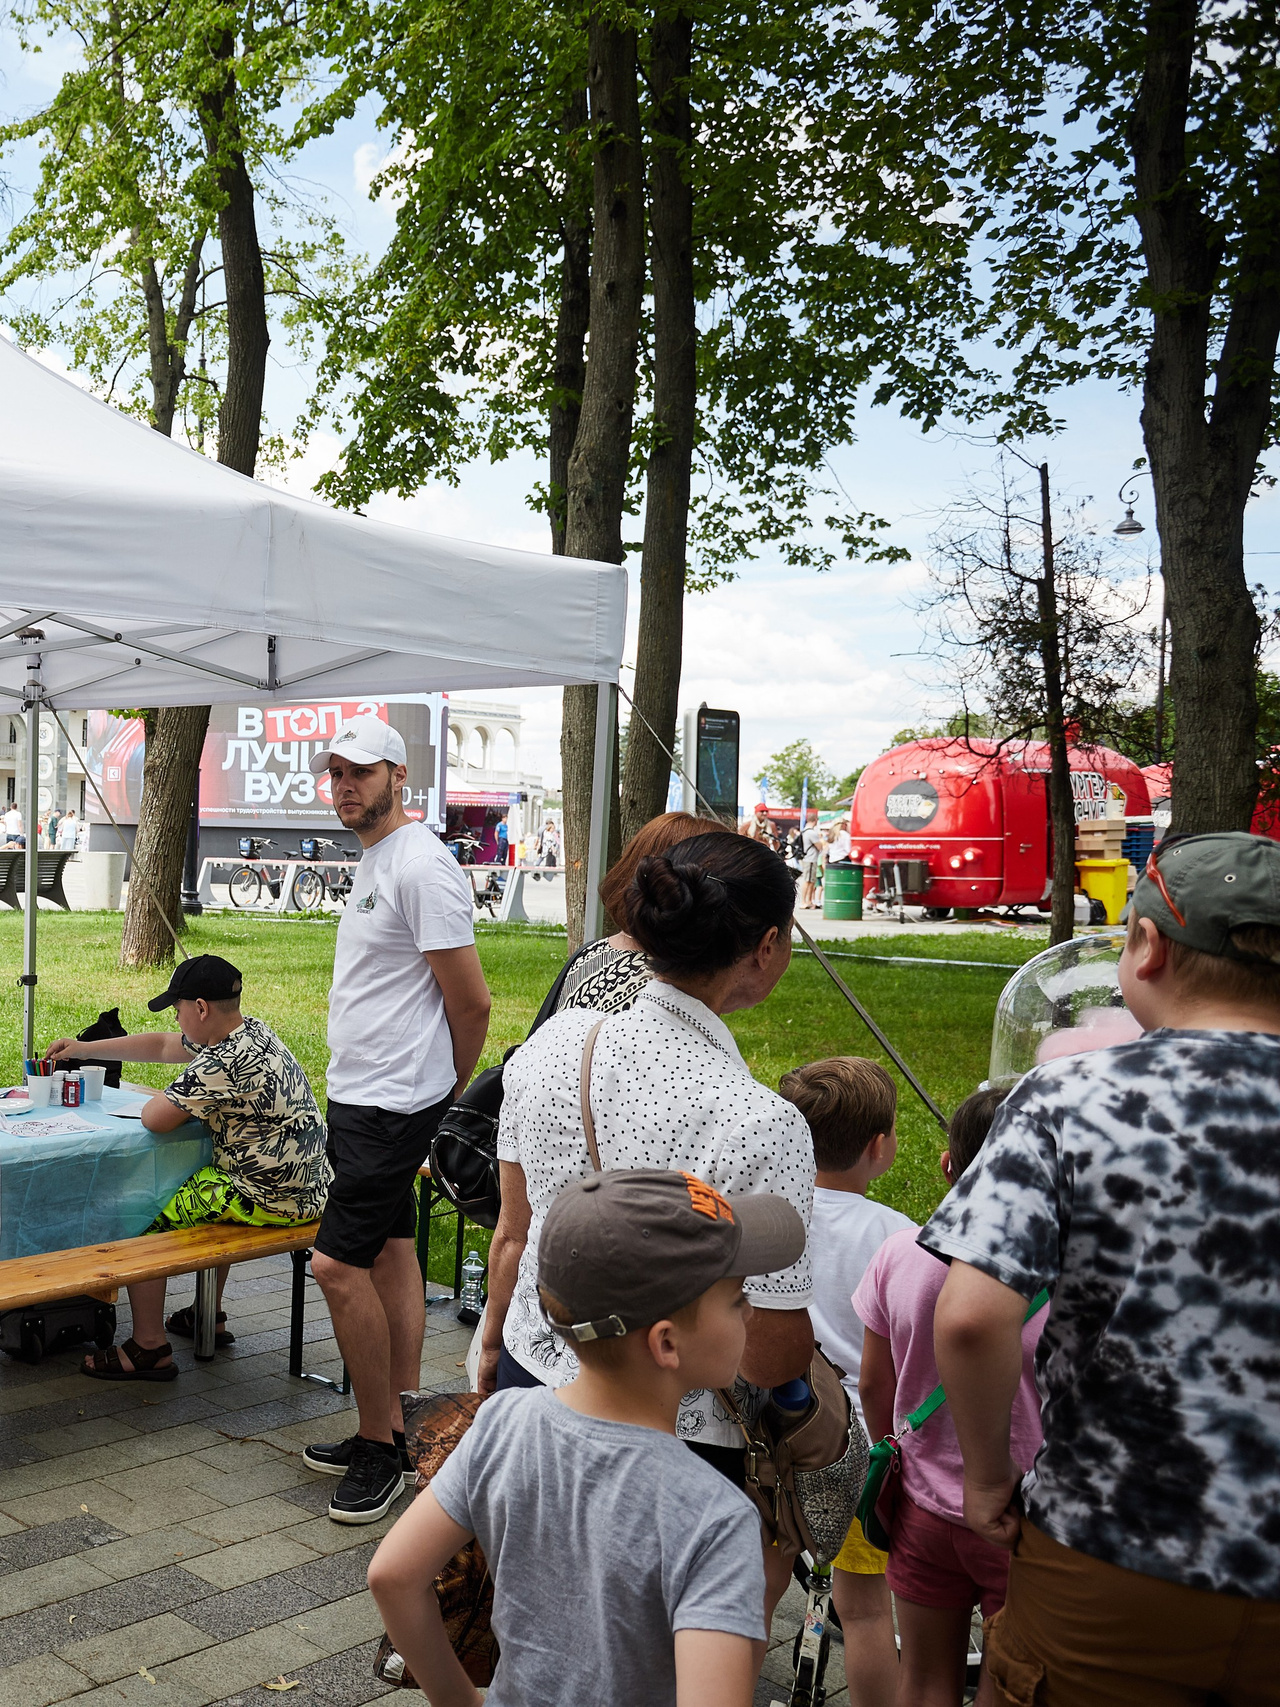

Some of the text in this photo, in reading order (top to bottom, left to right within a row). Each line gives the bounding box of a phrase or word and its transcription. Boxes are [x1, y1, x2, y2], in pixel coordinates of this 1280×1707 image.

[237, 707, 263, 738] В
[1069, 771, 1106, 799] УРГЕР
[236, 807, 287, 815] трудоустройства
